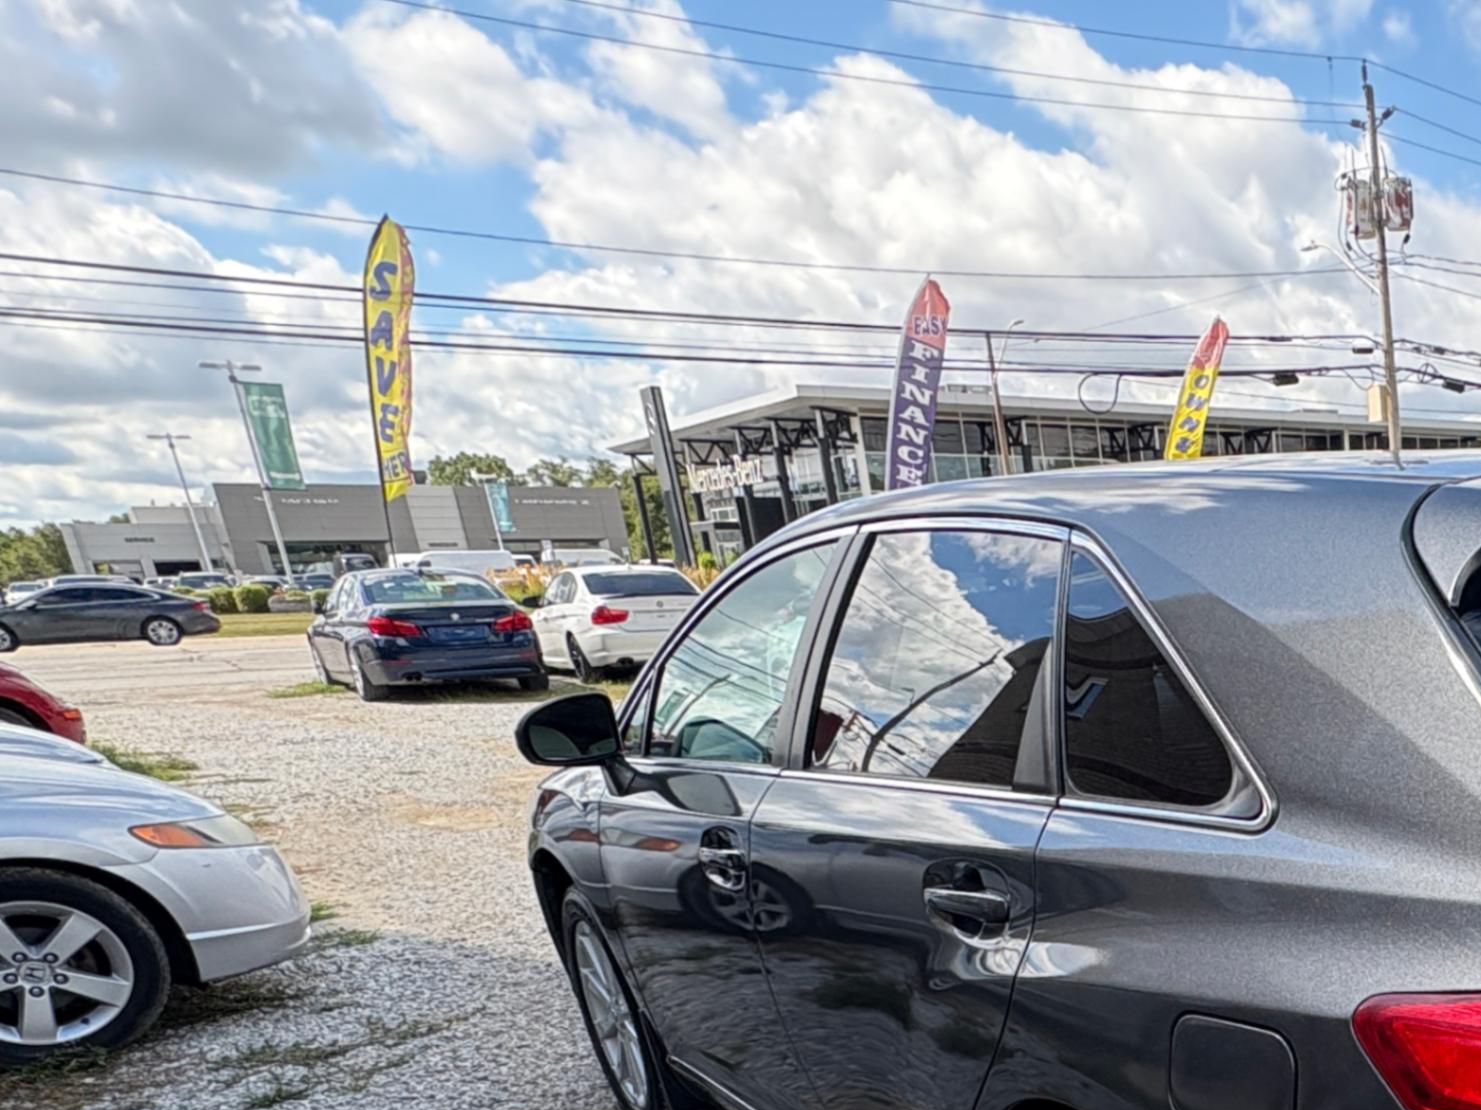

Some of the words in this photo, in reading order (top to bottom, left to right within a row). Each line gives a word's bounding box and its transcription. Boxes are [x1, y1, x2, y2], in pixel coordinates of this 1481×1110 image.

[368, 261, 399, 444] SAVE
[914, 315, 947, 336] EASY
[896, 339, 939, 486] FINANCE
